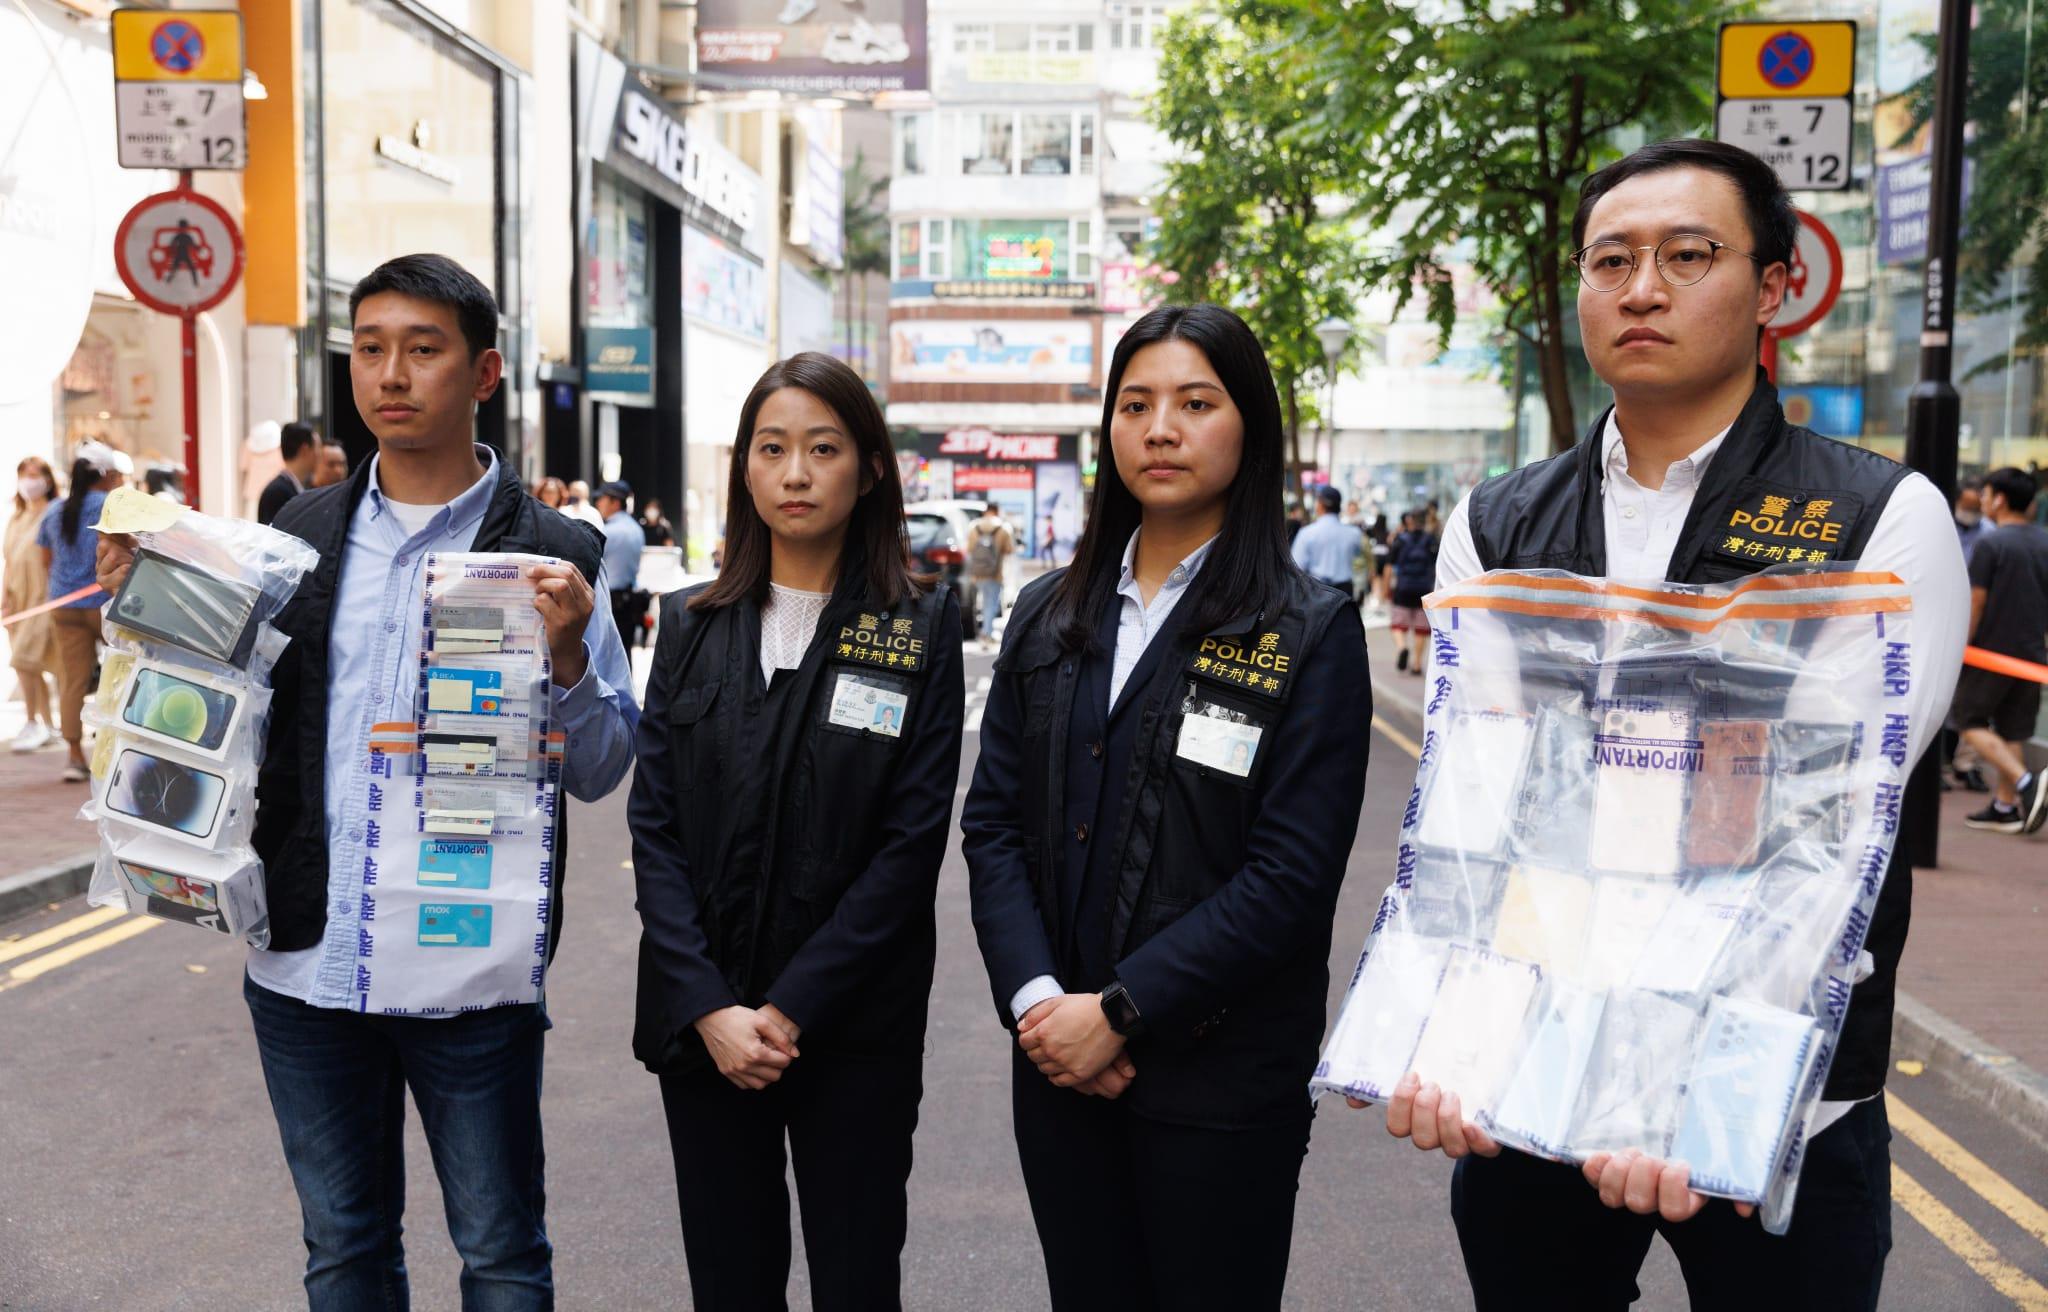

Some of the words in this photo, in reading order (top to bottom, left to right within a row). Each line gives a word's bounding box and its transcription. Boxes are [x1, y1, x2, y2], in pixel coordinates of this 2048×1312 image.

[197, 89, 215, 117] 7
[1750, 104, 1773, 114] am
[1742, 118, 1779, 136] 上午
[1804, 105, 1824, 134] 7
[202, 137, 235, 163] 12
[1804, 154, 1840, 183] 12
[1759, 495, 1834, 519] 警察
[1729, 509, 1842, 543] POLICE
[1722, 535, 1828, 566] 灣仔刑事部
[464, 567, 519, 580] IMPORTANT
[858, 613, 913, 636] 警察
[839, 626, 923, 653] POLICE
[837, 643, 916, 669] 灣仔刑事部
[1199, 638, 1290, 673] POLICE
[1193, 656, 1280, 694] 灣仔刑事部
[1882, 642, 1911, 696] HKP
[1881, 714, 1909, 768] HKP
[1589, 745, 1704, 772] IMPORTANT
[545, 792, 557, 818] HKP
[1873, 782, 1901, 834] HKP
[433, 842, 488, 855] IMPORTANT
[542, 826, 555, 852] HKP
[540, 862, 552, 888] HKP
[1397, 844, 1415, 889] HKP
[424, 905, 450, 914] mox
[537, 897, 549, 924] HKP
[534, 933, 547, 958] HKP
[531, 965, 544, 988] HKP
